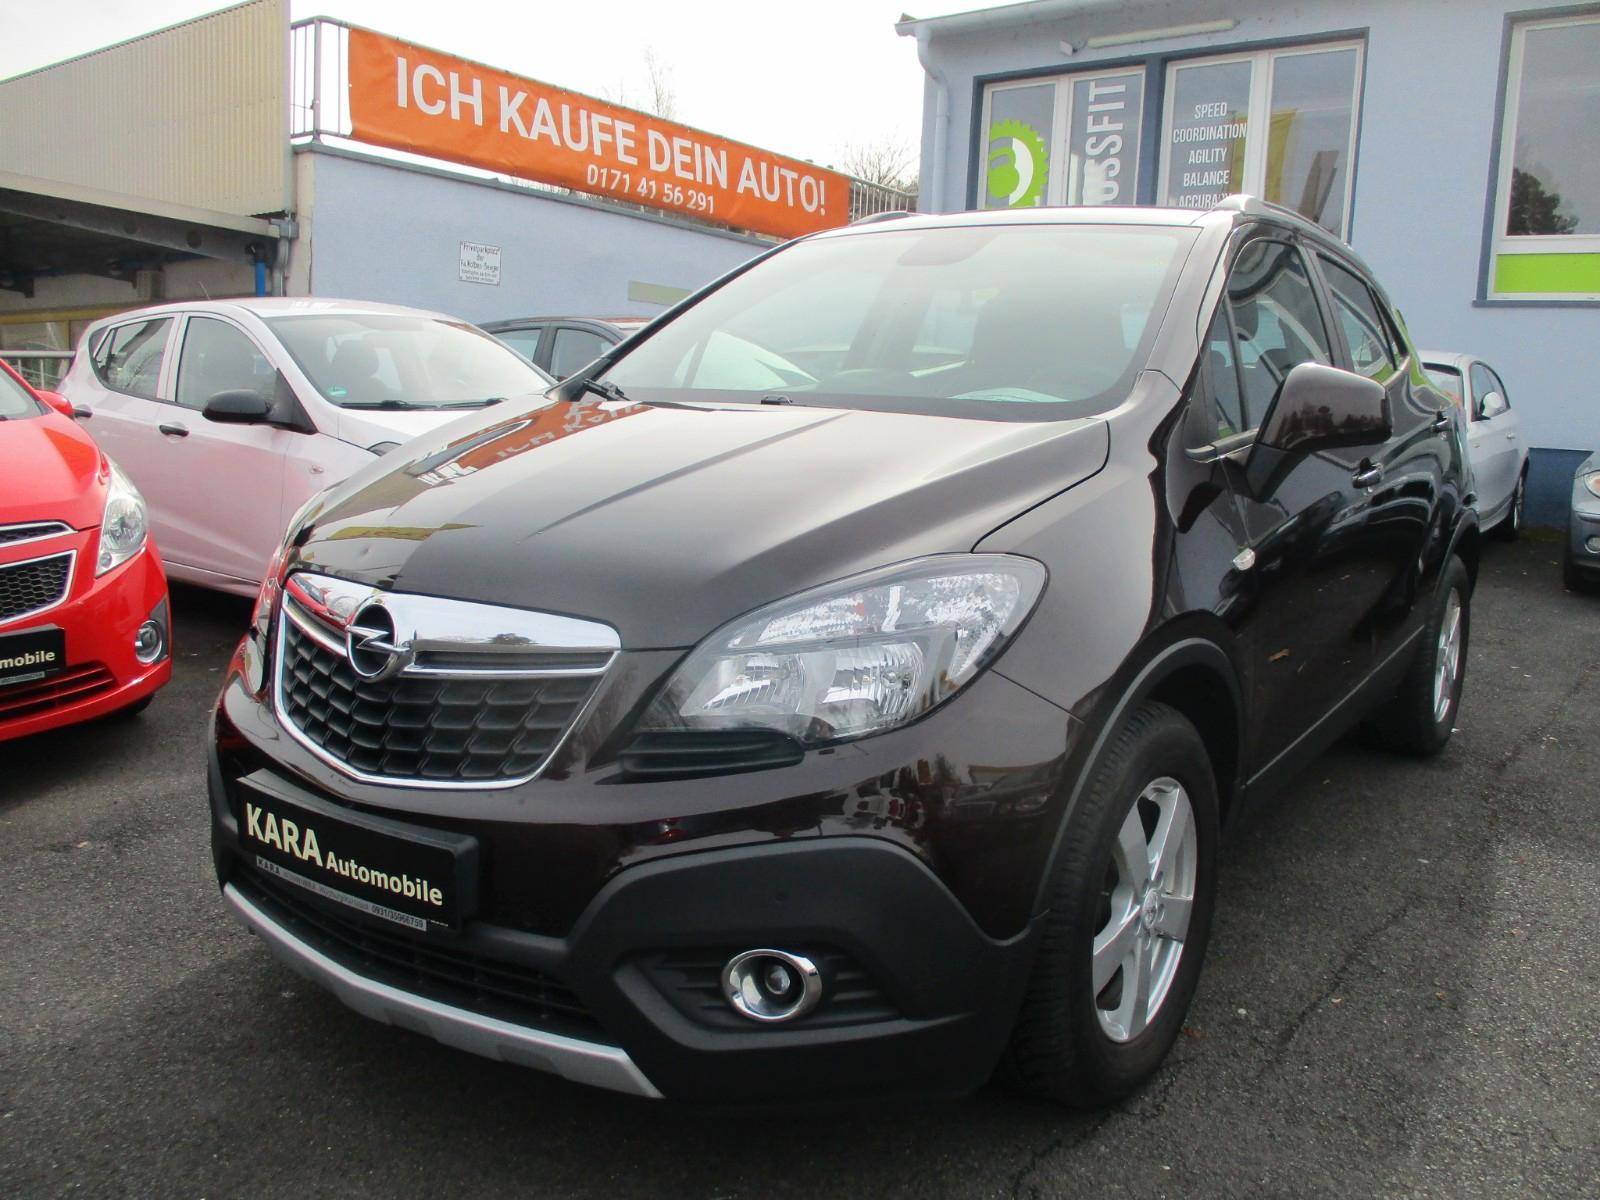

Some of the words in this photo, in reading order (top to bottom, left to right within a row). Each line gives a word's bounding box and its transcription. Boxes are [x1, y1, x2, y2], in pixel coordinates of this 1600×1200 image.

[1194, 102, 1227, 119] SPEED
[397, 56, 484, 127] ICH
[499, 85, 638, 166] KAUFE
[647, 129, 727, 190] DEIN
[736, 156, 826, 216] AUTO!
[1173, 123, 1247, 143] COORDINATION
[1188, 147, 1228, 165] AGILITY
[587, 163, 630, 193] 0171
[636, 176, 657, 199] 41
[662, 183, 684, 206] 56
[686, 189, 714, 214] 291
[1183, 170, 1230, 187] BALANCE
[246, 802, 323, 867] KARA
[326, 851, 443, 906] Automobile
